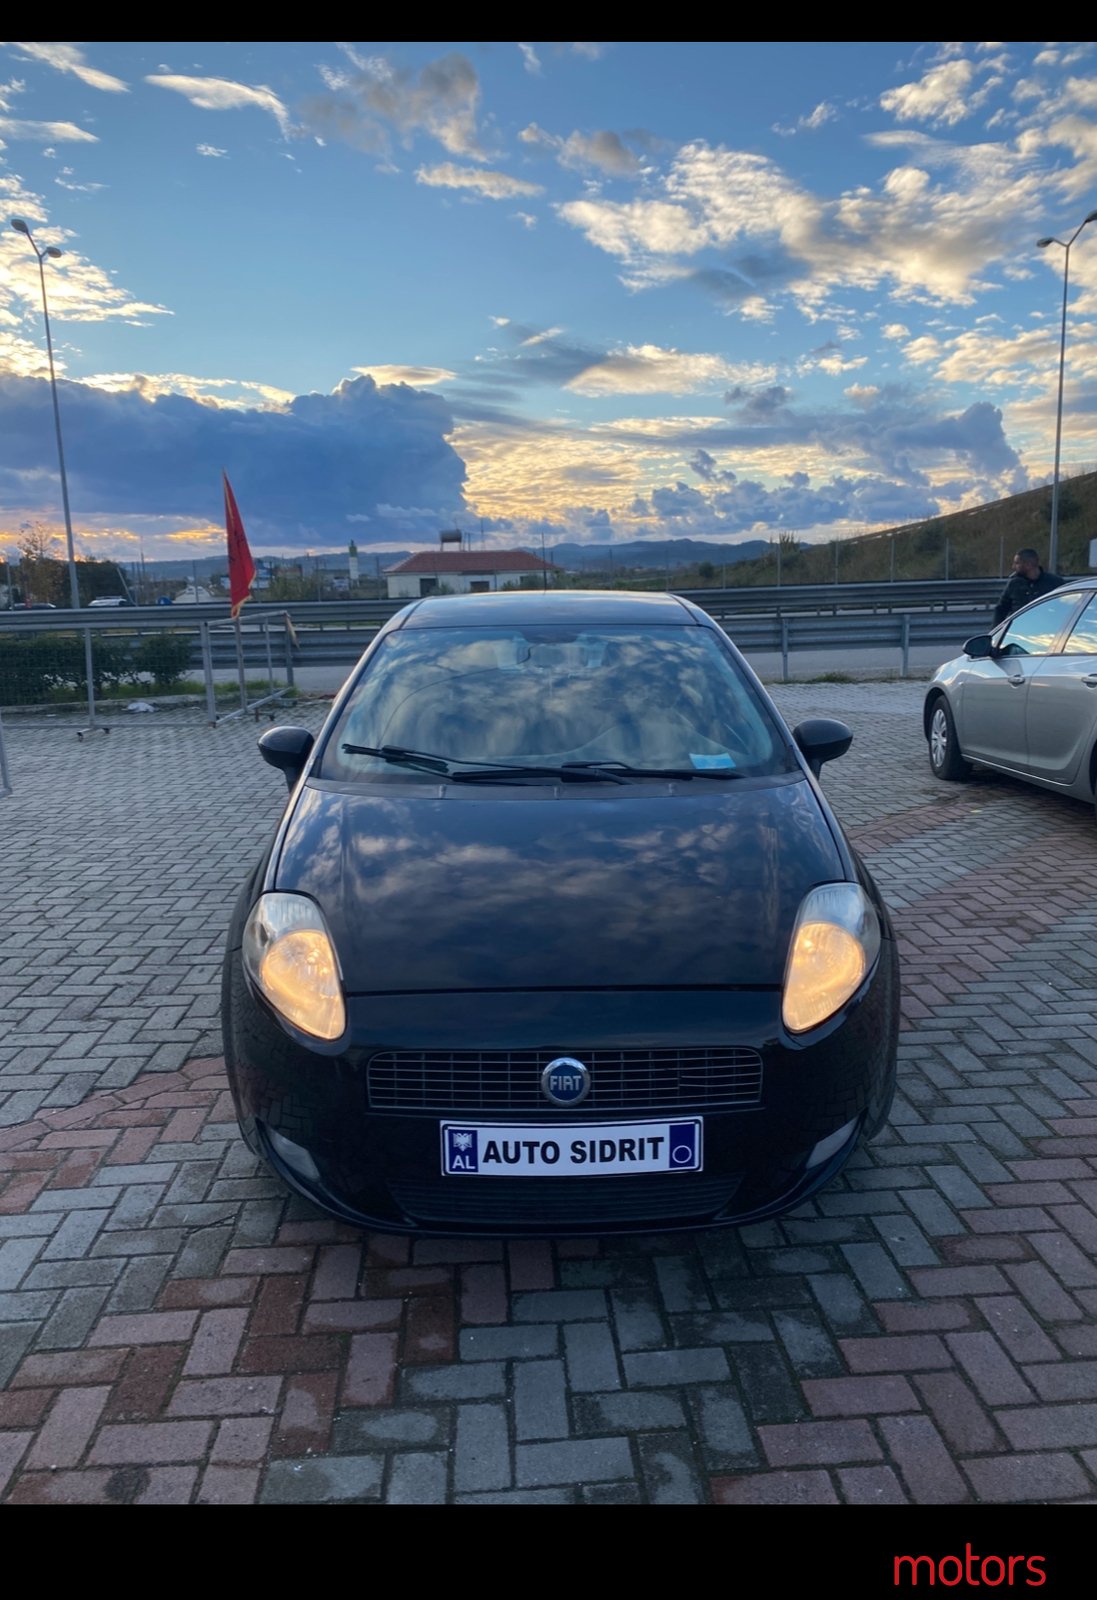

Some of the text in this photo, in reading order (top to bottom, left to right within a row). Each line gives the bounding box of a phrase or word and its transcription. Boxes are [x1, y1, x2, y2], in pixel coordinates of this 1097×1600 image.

[550, 1075, 582, 1091] FIAT
[482, 1137, 664, 1164] AUTO SIDRIT
[452, 1155, 476, 1170] AL
